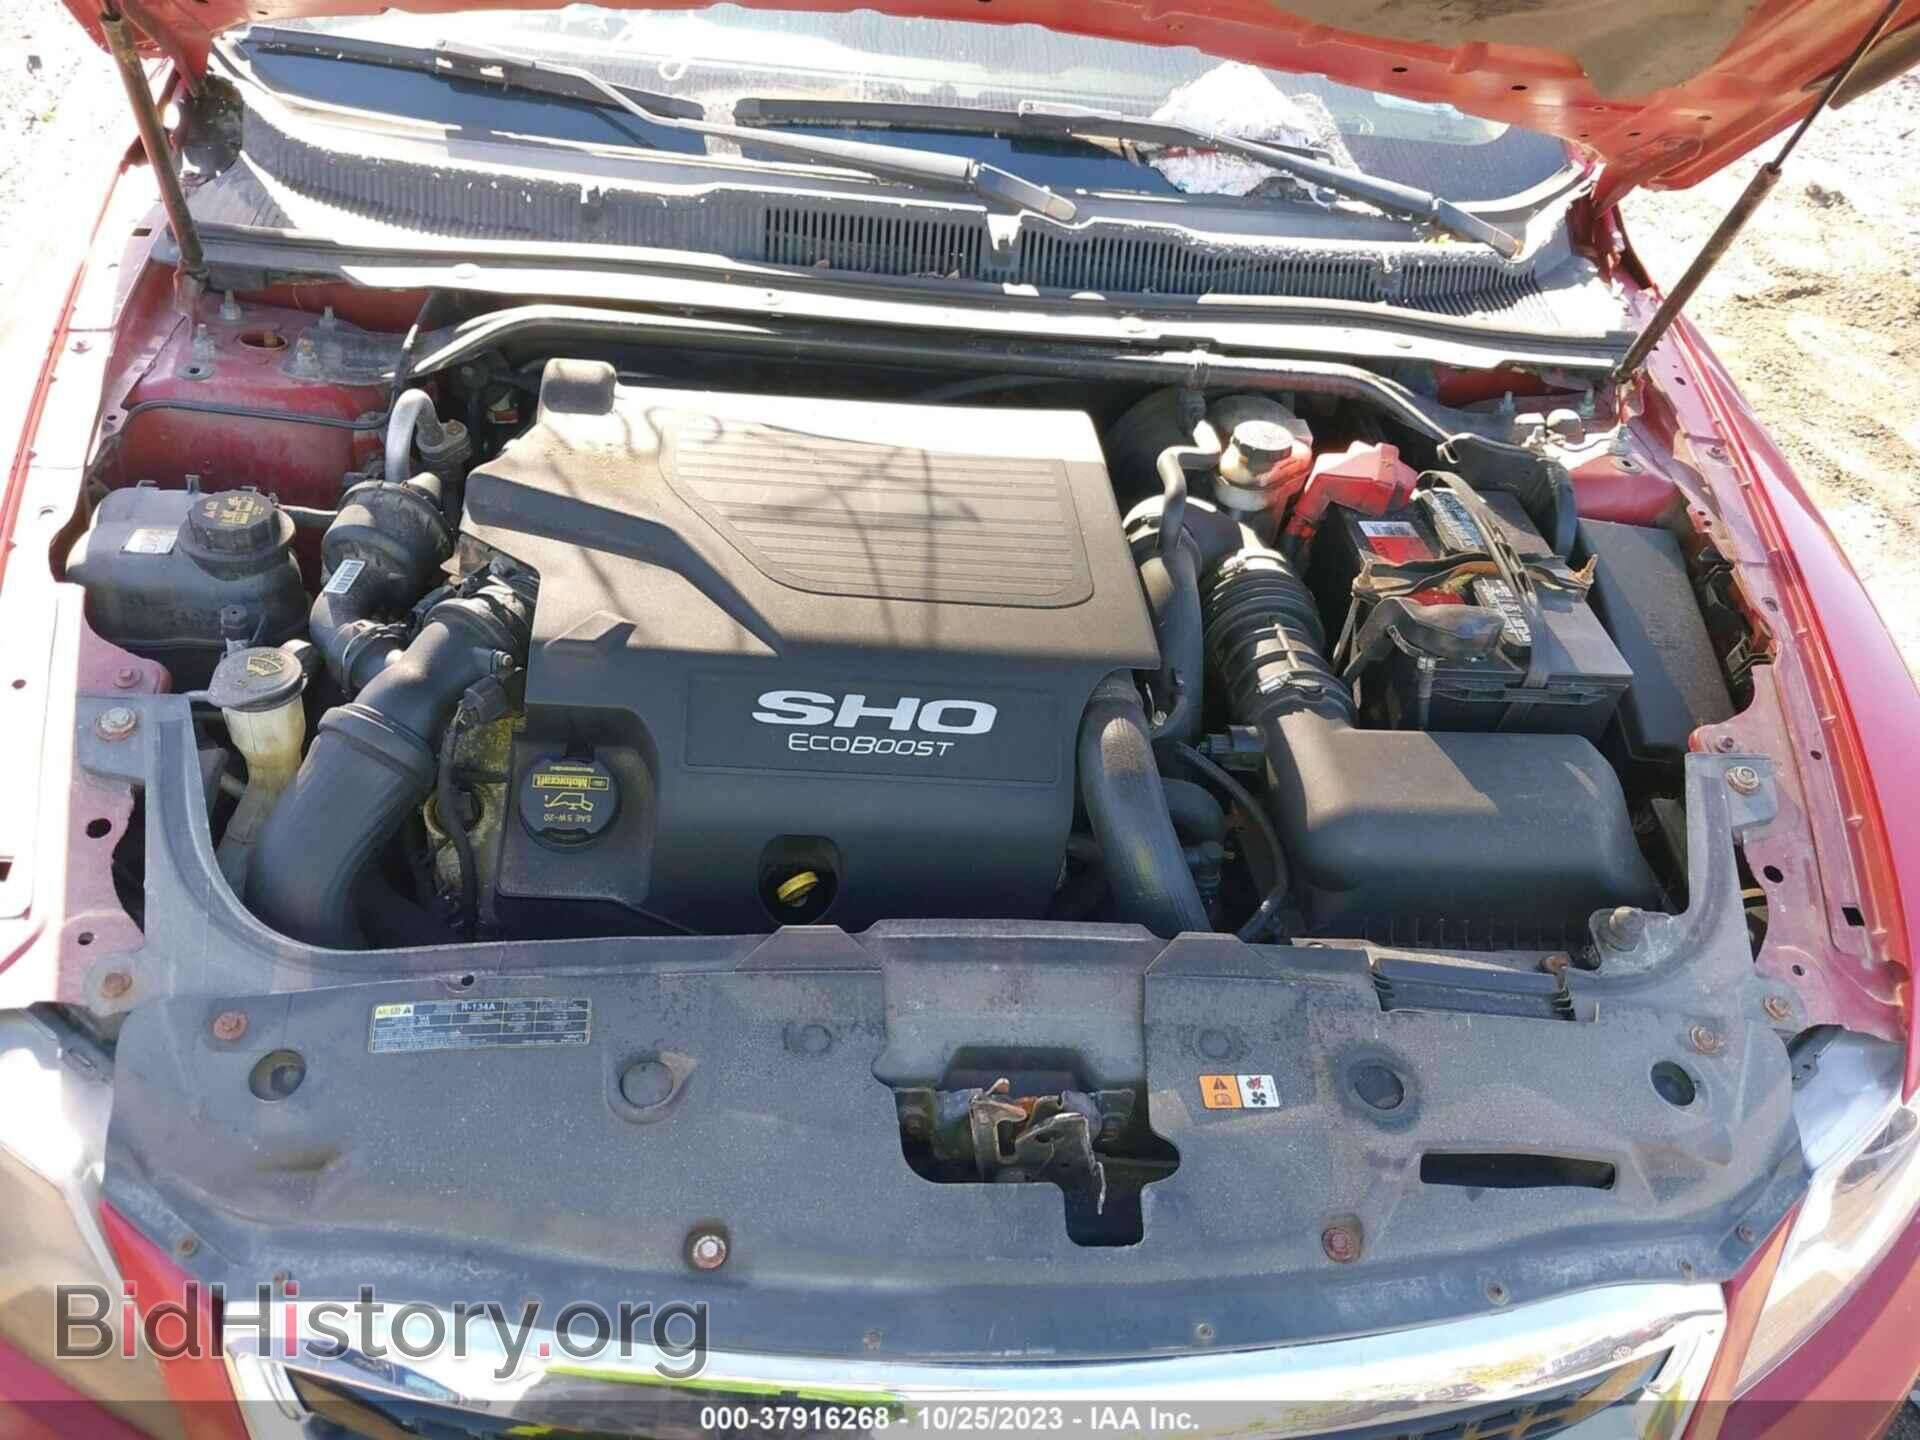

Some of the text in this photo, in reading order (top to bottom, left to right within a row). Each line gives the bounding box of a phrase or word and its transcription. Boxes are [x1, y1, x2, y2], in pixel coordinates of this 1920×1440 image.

[752, 690, 997, 735] SHO
[537, 776, 588, 789] Motorcraft
[543, 813, 592, 823] SAE 5W-20
